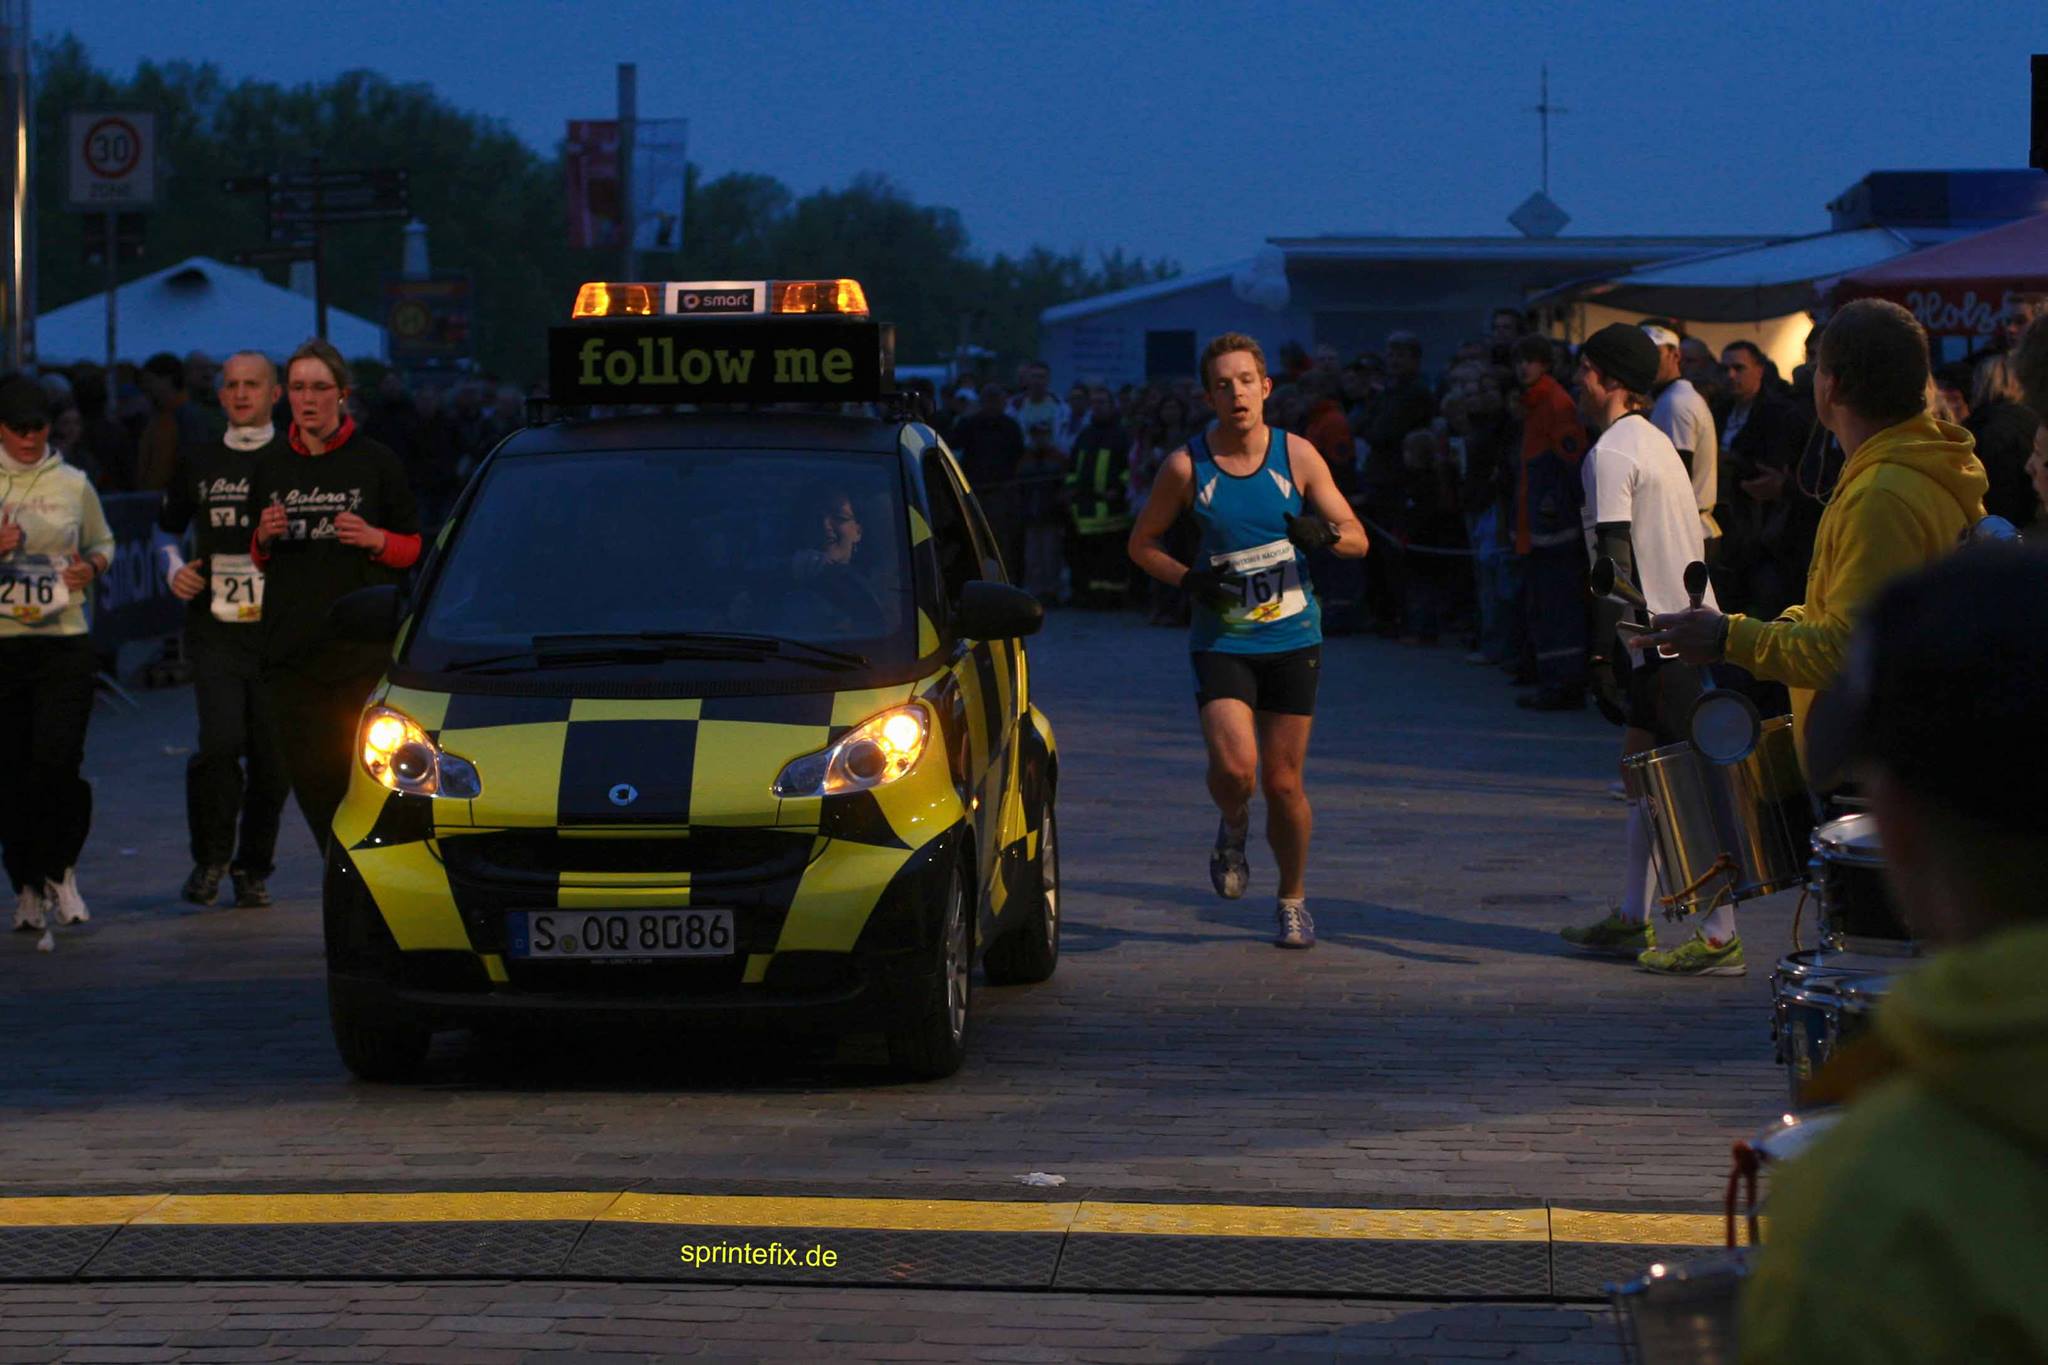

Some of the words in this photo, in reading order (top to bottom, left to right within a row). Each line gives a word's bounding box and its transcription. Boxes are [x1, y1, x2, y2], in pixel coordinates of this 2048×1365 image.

[93, 134, 128, 162] 30
[702, 295, 749, 307] smart
[578, 336, 755, 386] follow
[772, 346, 855, 385] me
[285, 482, 347, 504] Bolero
[0, 575, 53, 604] 216
[225, 576, 265, 603] 21
[534, 916, 556, 950] S
[639, 915, 730, 949] 8086
